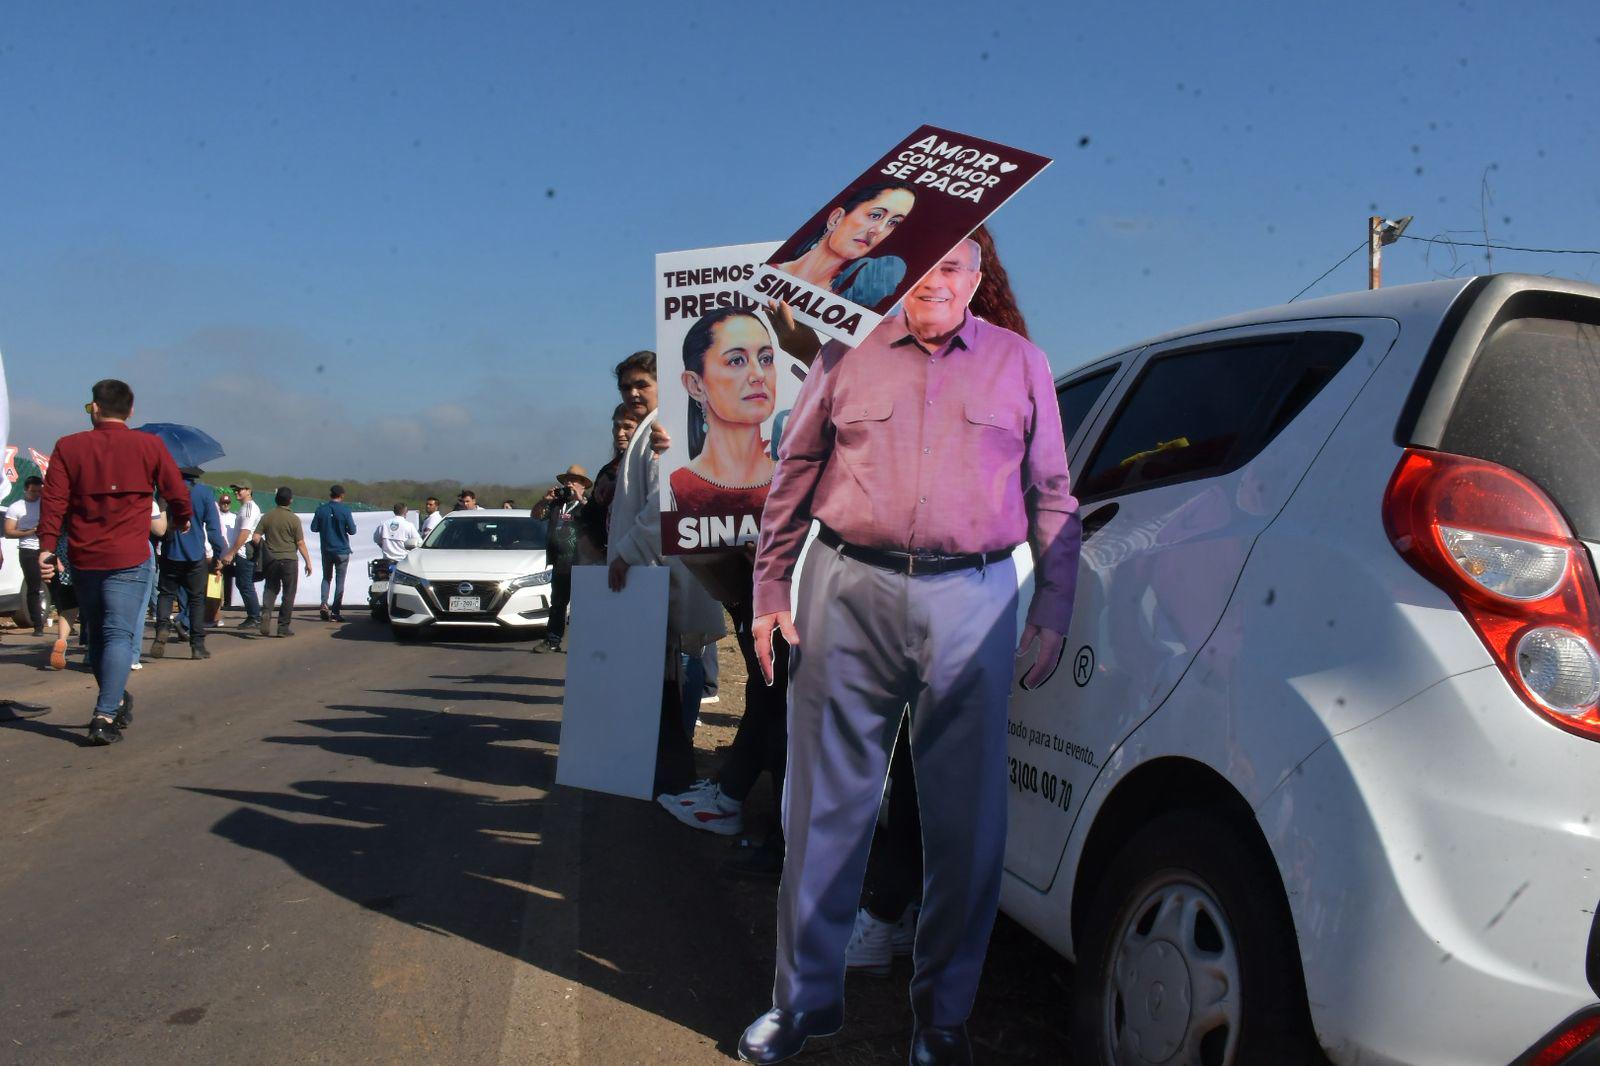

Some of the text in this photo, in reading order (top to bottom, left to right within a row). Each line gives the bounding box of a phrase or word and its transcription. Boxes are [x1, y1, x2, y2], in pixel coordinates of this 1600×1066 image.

[898, 151, 1001, 188] CON AMOR
[908, 135, 1000, 171] AMOR
[880, 161, 985, 204] SE PAGA
[664, 264, 754, 288] TENEMOS
[664, 290, 766, 320] PRESID
[753, 274, 864, 337] SINALOA
[1008, 719, 1027, 739] todo
[1029, 729, 1051, 748] para
[1053, 735, 1064, 752] tu
[1041, 770, 1057, 803] 00
[1058, 778, 1072, 812] 70
